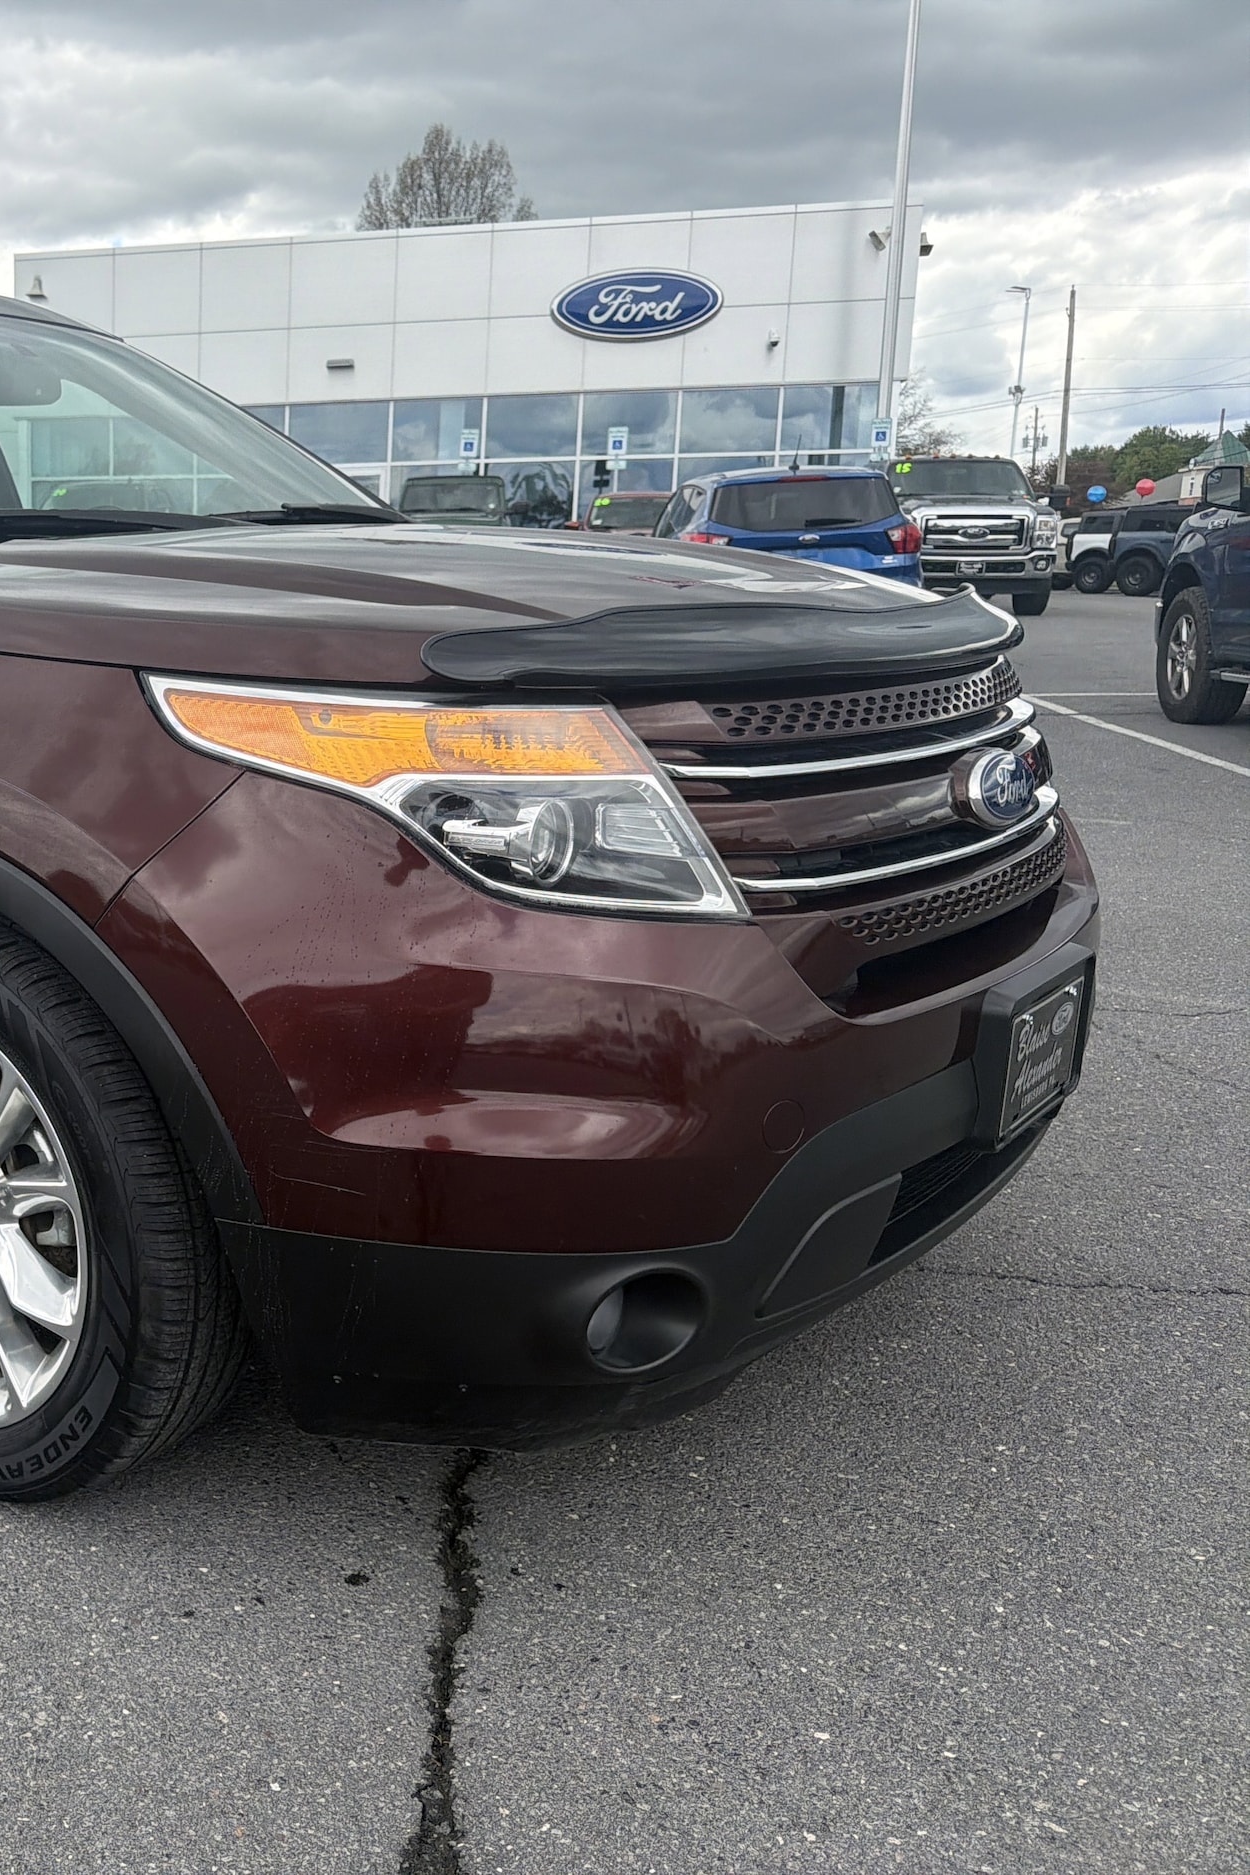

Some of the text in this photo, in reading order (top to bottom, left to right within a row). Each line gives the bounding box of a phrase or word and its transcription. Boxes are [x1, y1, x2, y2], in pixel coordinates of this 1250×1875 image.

[588, 284, 686, 325] Ford
[895, 462, 913, 474] 15
[996, 752, 1032, 807] Ford
[1018, 1022, 1051, 1061] Blaise
[1011, 1040, 1062, 1103] Alexander
